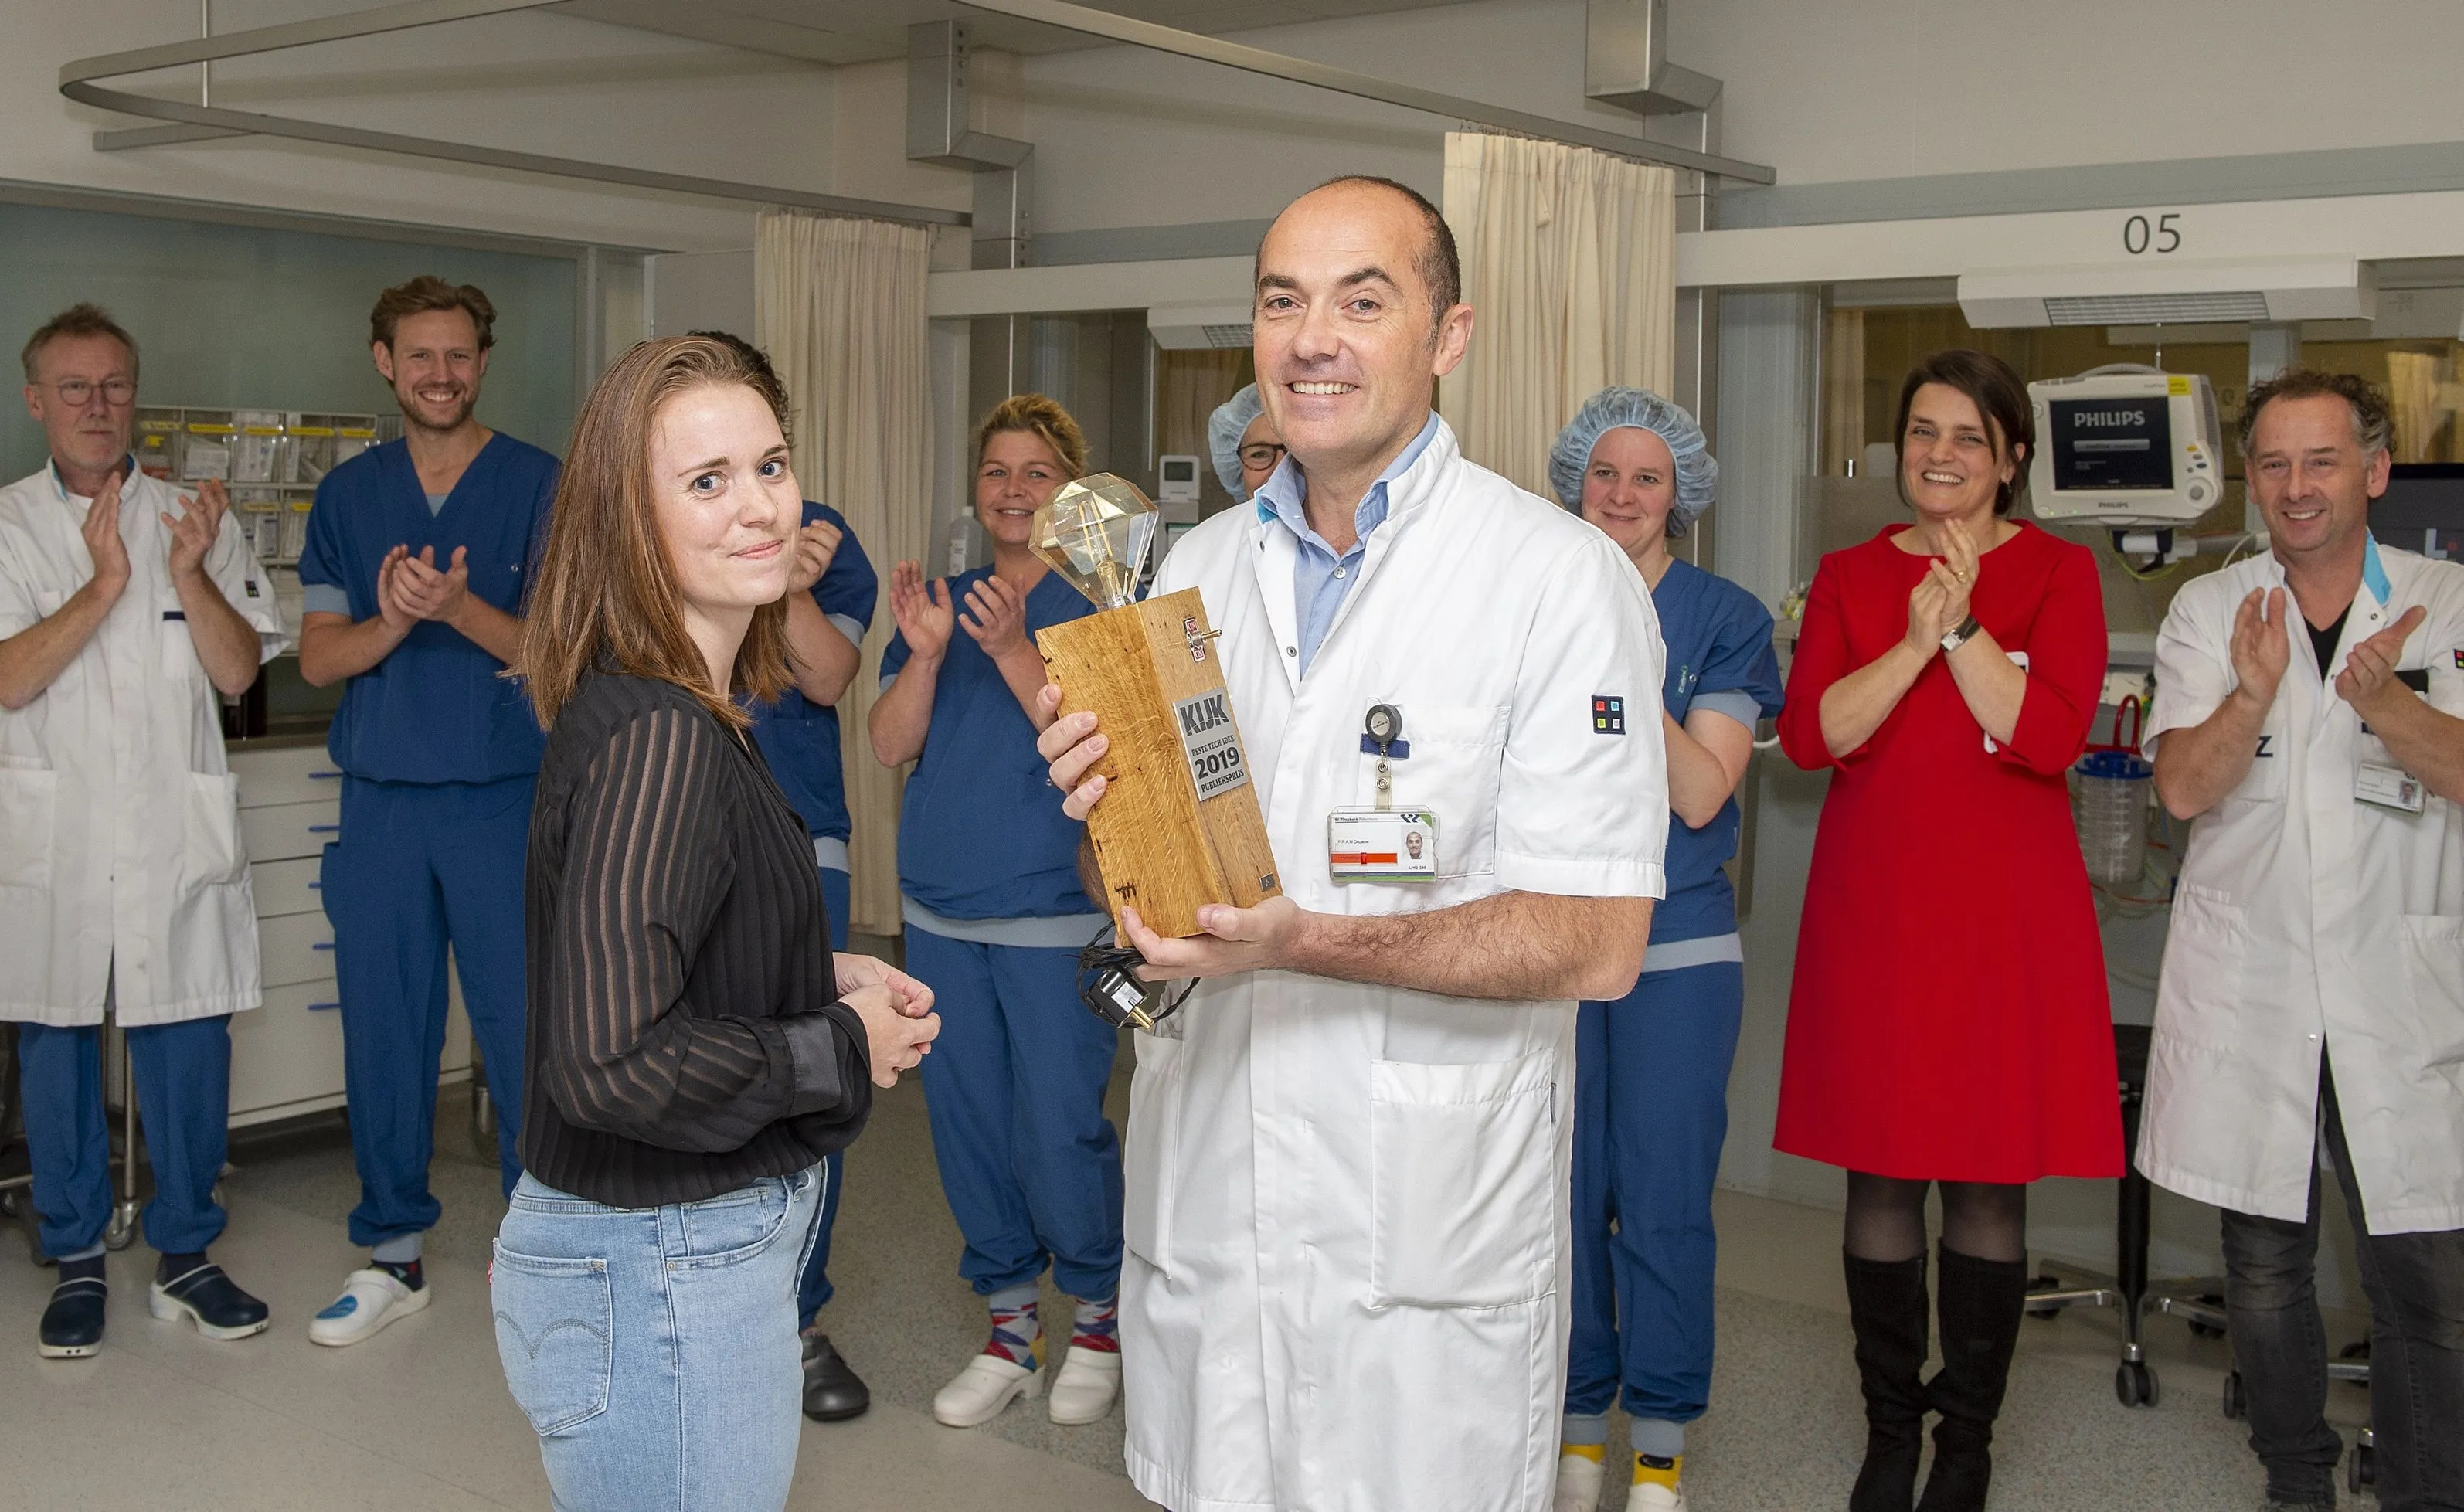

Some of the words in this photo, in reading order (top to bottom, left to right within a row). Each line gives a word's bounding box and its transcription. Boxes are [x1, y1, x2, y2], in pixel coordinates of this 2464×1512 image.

[2124, 214, 2180, 254] 05
[2074, 410, 2146, 427] PHILIPS
[1187, 621, 1197, 630] ON
[1195, 650, 1204, 658] ON
[1180, 694, 1229, 736] KIJK
[1191, 744, 1208, 756] BESTE
[1207, 735, 1235, 750] TECH-IDEE
[1195, 746, 1239, 780] 2019
[1201, 769, 1244, 793] PUBLIEKSPRIJS
